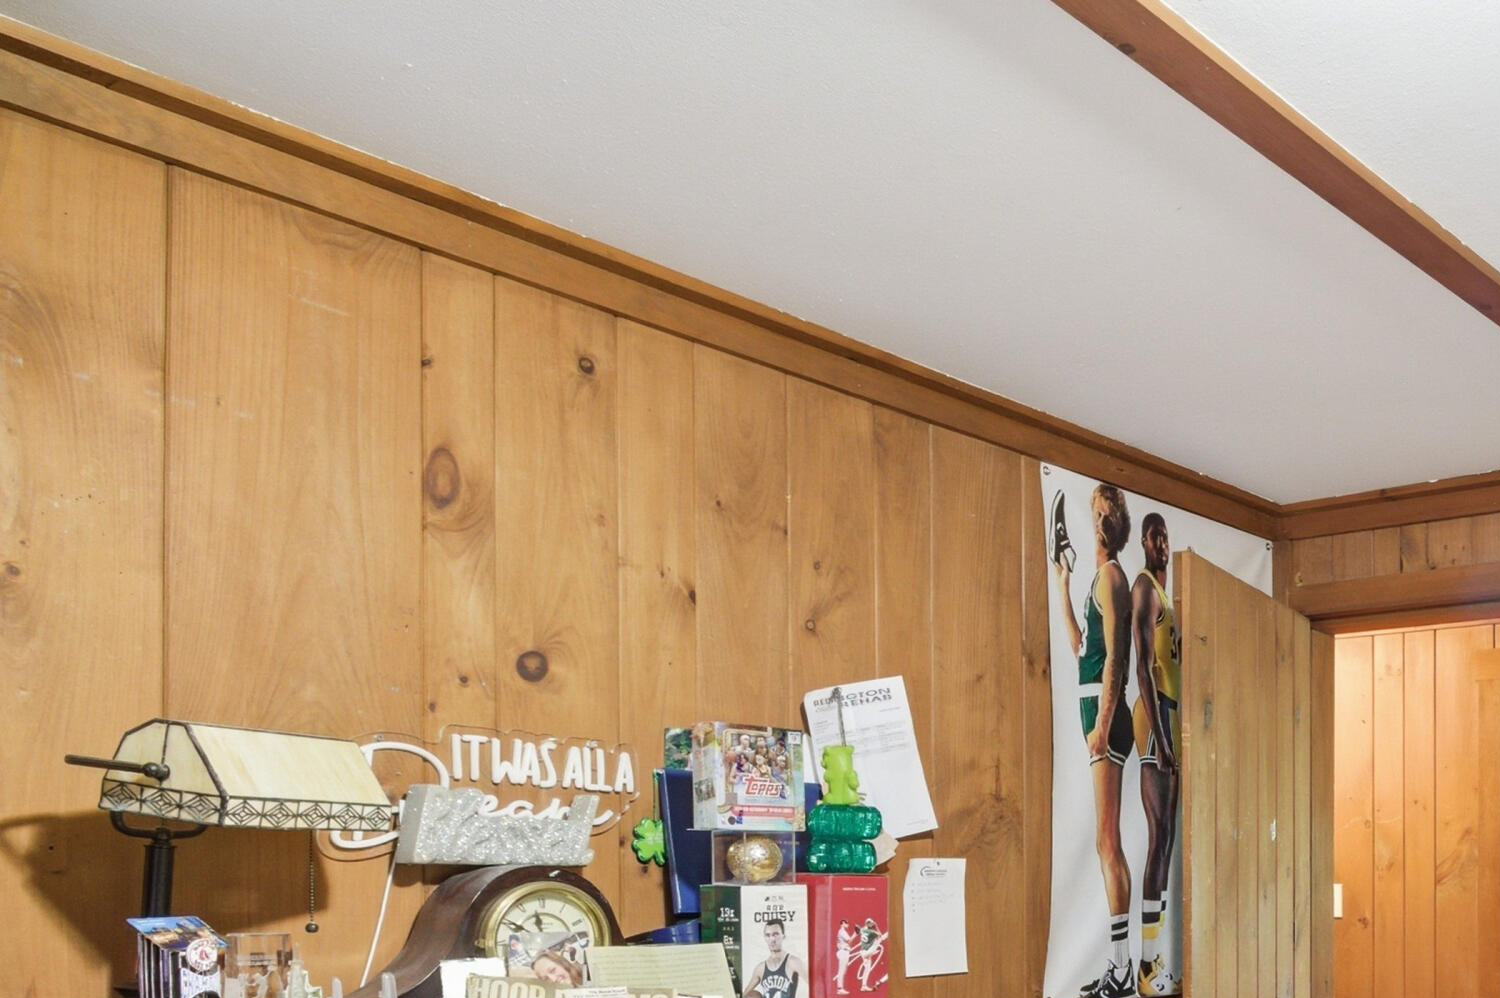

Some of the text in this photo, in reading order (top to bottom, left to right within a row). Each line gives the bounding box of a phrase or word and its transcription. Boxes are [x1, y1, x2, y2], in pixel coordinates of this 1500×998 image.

[451, 733, 635, 793] IT WAS ALL A
[754, 911, 796, 923] COUSY
